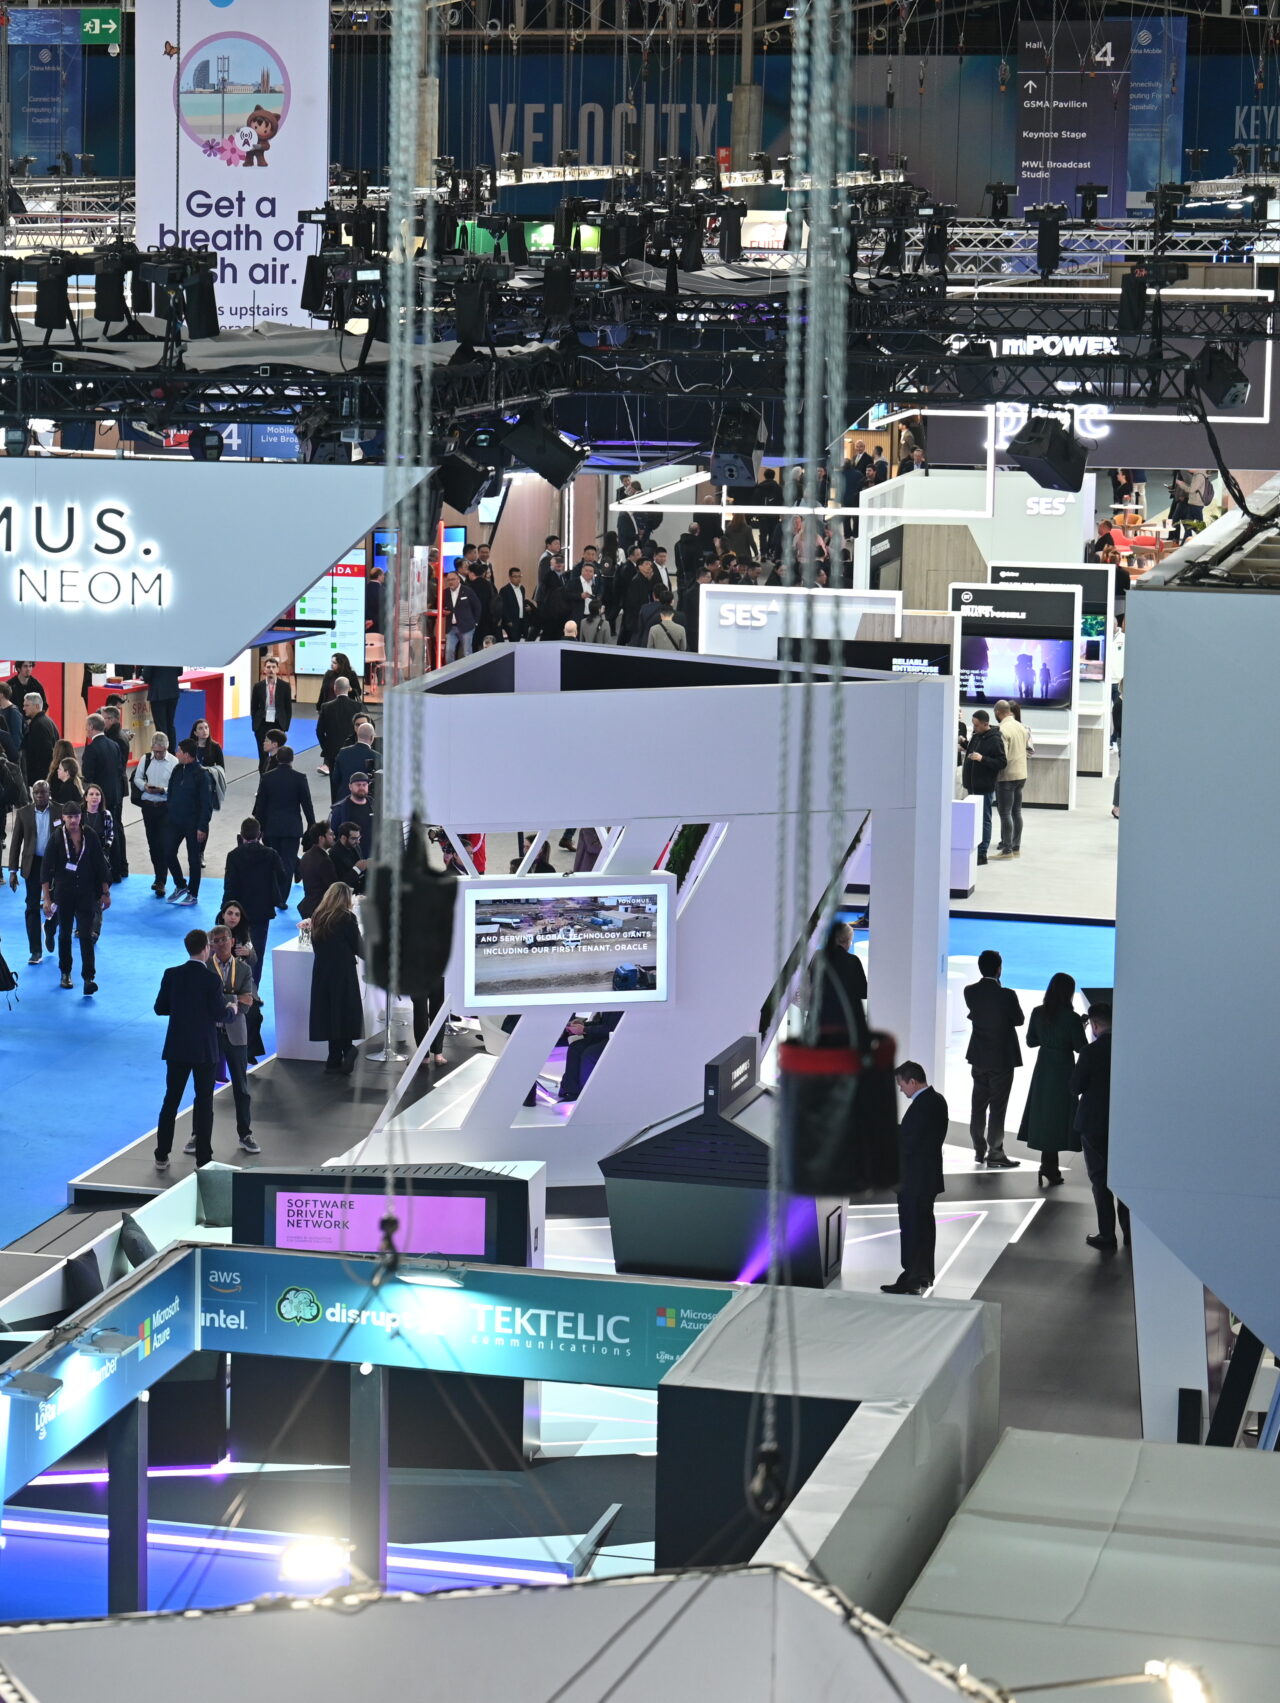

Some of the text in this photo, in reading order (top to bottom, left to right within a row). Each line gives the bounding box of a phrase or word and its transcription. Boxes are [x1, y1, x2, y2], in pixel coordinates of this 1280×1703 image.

[1025, 41, 1115, 67] Hall 4
[1234, 105, 1280, 140] KEY
[1022, 130, 1087, 140] Keynote Stage
[1021, 170, 1050, 179] Studio
[1022, 160, 1091, 169] MWL Broadcast
[185, 189, 276, 219] Get a
[159, 222, 305, 252] breath of
[248, 256, 297, 285] air.
[229, 303, 288, 320] upstairs
[222, 423, 294, 451] 4 Mobile
[261, 435, 278, 443] Live
[1025, 496, 1067, 516] SES
[18, 567, 165, 608] NEOM
[719, 603, 769, 627] SES
[480, 930, 652, 943] AND SERVING GLOBAL TECHNOLOGY GIANTS
[483, 946, 529, 955] INCLUDING
[531, 946, 549, 954] OUR
[551, 945, 576, 953] FIRST
[614, 942, 648, 952] ORACLE
[287, 1198, 355, 1210] SOFTWARE
[287, 1208, 333, 1219] DRIVEN
[286, 1218, 350, 1230] NETWORK
[209, 1270, 241, 1285] aws
[152, 1295, 180, 1331] Microsoft
[471, 1302, 630, 1344] TEKTELIC
[152, 1327, 171, 1352] Azure
[471, 1333, 632, 1357] communications
